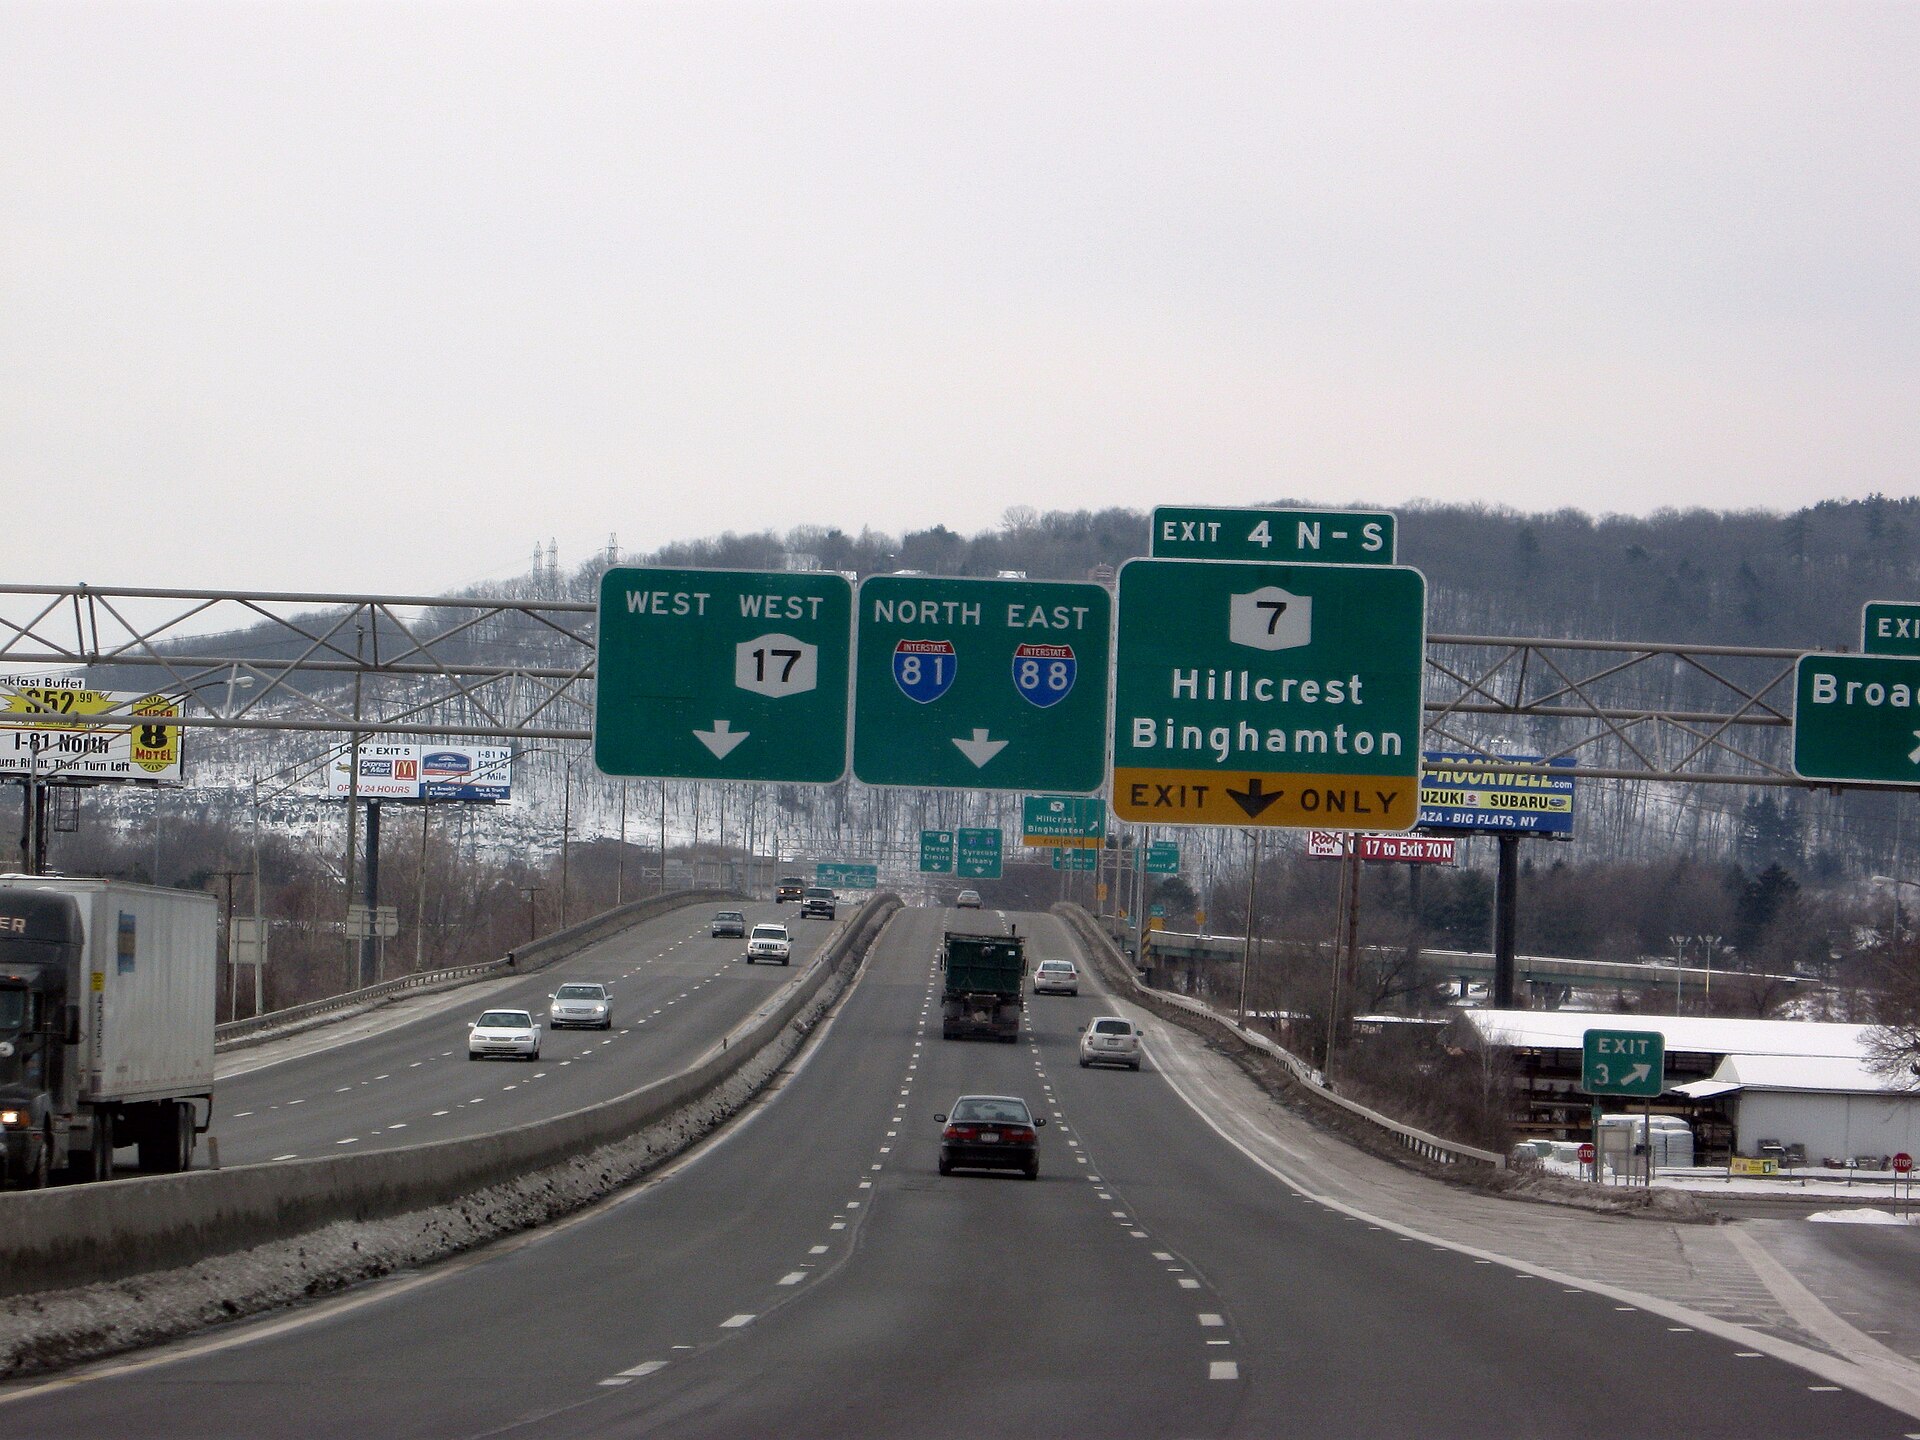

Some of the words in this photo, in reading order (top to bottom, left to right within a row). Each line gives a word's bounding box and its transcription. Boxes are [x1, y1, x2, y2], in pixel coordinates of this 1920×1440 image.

[1163, 521, 1222, 543] EXIT
[1247, 520, 1273, 549] 4
[626, 590, 711, 616] WEST
[739, 594, 824, 620] WEST
[874, 599, 981, 626] NORTH
[1007, 604, 1089, 630] EAST
[1256, 601, 1287, 635] 7
[903, 643, 947, 653] INTERSTATE
[1023, 647, 1066, 657] INTERSTATE
[752, 648, 802, 683] 17
[901, 656, 943, 686] 81
[44, 677, 83, 689] Buffet
[1019, 660, 1068, 691] 88
[1172, 668, 1363, 705] Hillcrest
[1812, 673, 1920, 708] Broa
[15, 732, 50, 751] I-81
[59, 734, 109, 754] North
[140, 724, 168, 749] 8
[1132, 717, 1402, 763] Binghamton
[135, 747, 173, 761] MOTEL
[376, 747, 401, 756] EXIT
[404, 747, 411, 756] 5
[478, 750, 496, 758] I-81
[500, 751, 508, 759] N
[20, 757, 51, 770] Riht,
[54, 759, 80, 771] Then
[85, 760, 107, 771] Turn
[111, 761, 130, 772] Left
[361, 760, 391, 769] Express
[486, 772, 507, 781] Mile
[336, 784, 363, 793] OPN
[364, 784, 375, 793] 24
[377, 785, 410, 794] HOURS
[1131, 784, 1209, 809] EXIT
[1301, 789, 1398, 814] ONLY
[1490, 794, 1549, 809] SUBARU
[1036, 815, 1077, 824] Hillcrest
[1453, 813, 1474, 824] BIG
[1477, 815, 1516, 827] FLATS,
[1520, 817, 1538, 827] NY
[1028, 825, 1085, 834] Binghamton
[962, 848, 998, 857] Syracuse
[1365, 841, 1380, 855] 17
[1383, 843, 1396, 856] to
[1400, 842, 1424, 857] Exit
[1426, 843, 1441, 858] 70
[1442, 844, 1451, 858] N
[966, 857, 993, 866] Albany
[1598, 1038, 1650, 1055] EXIT
[1594, 1063, 1610, 1086] 3
[1894, 1158, 1911, 1167] STOP
